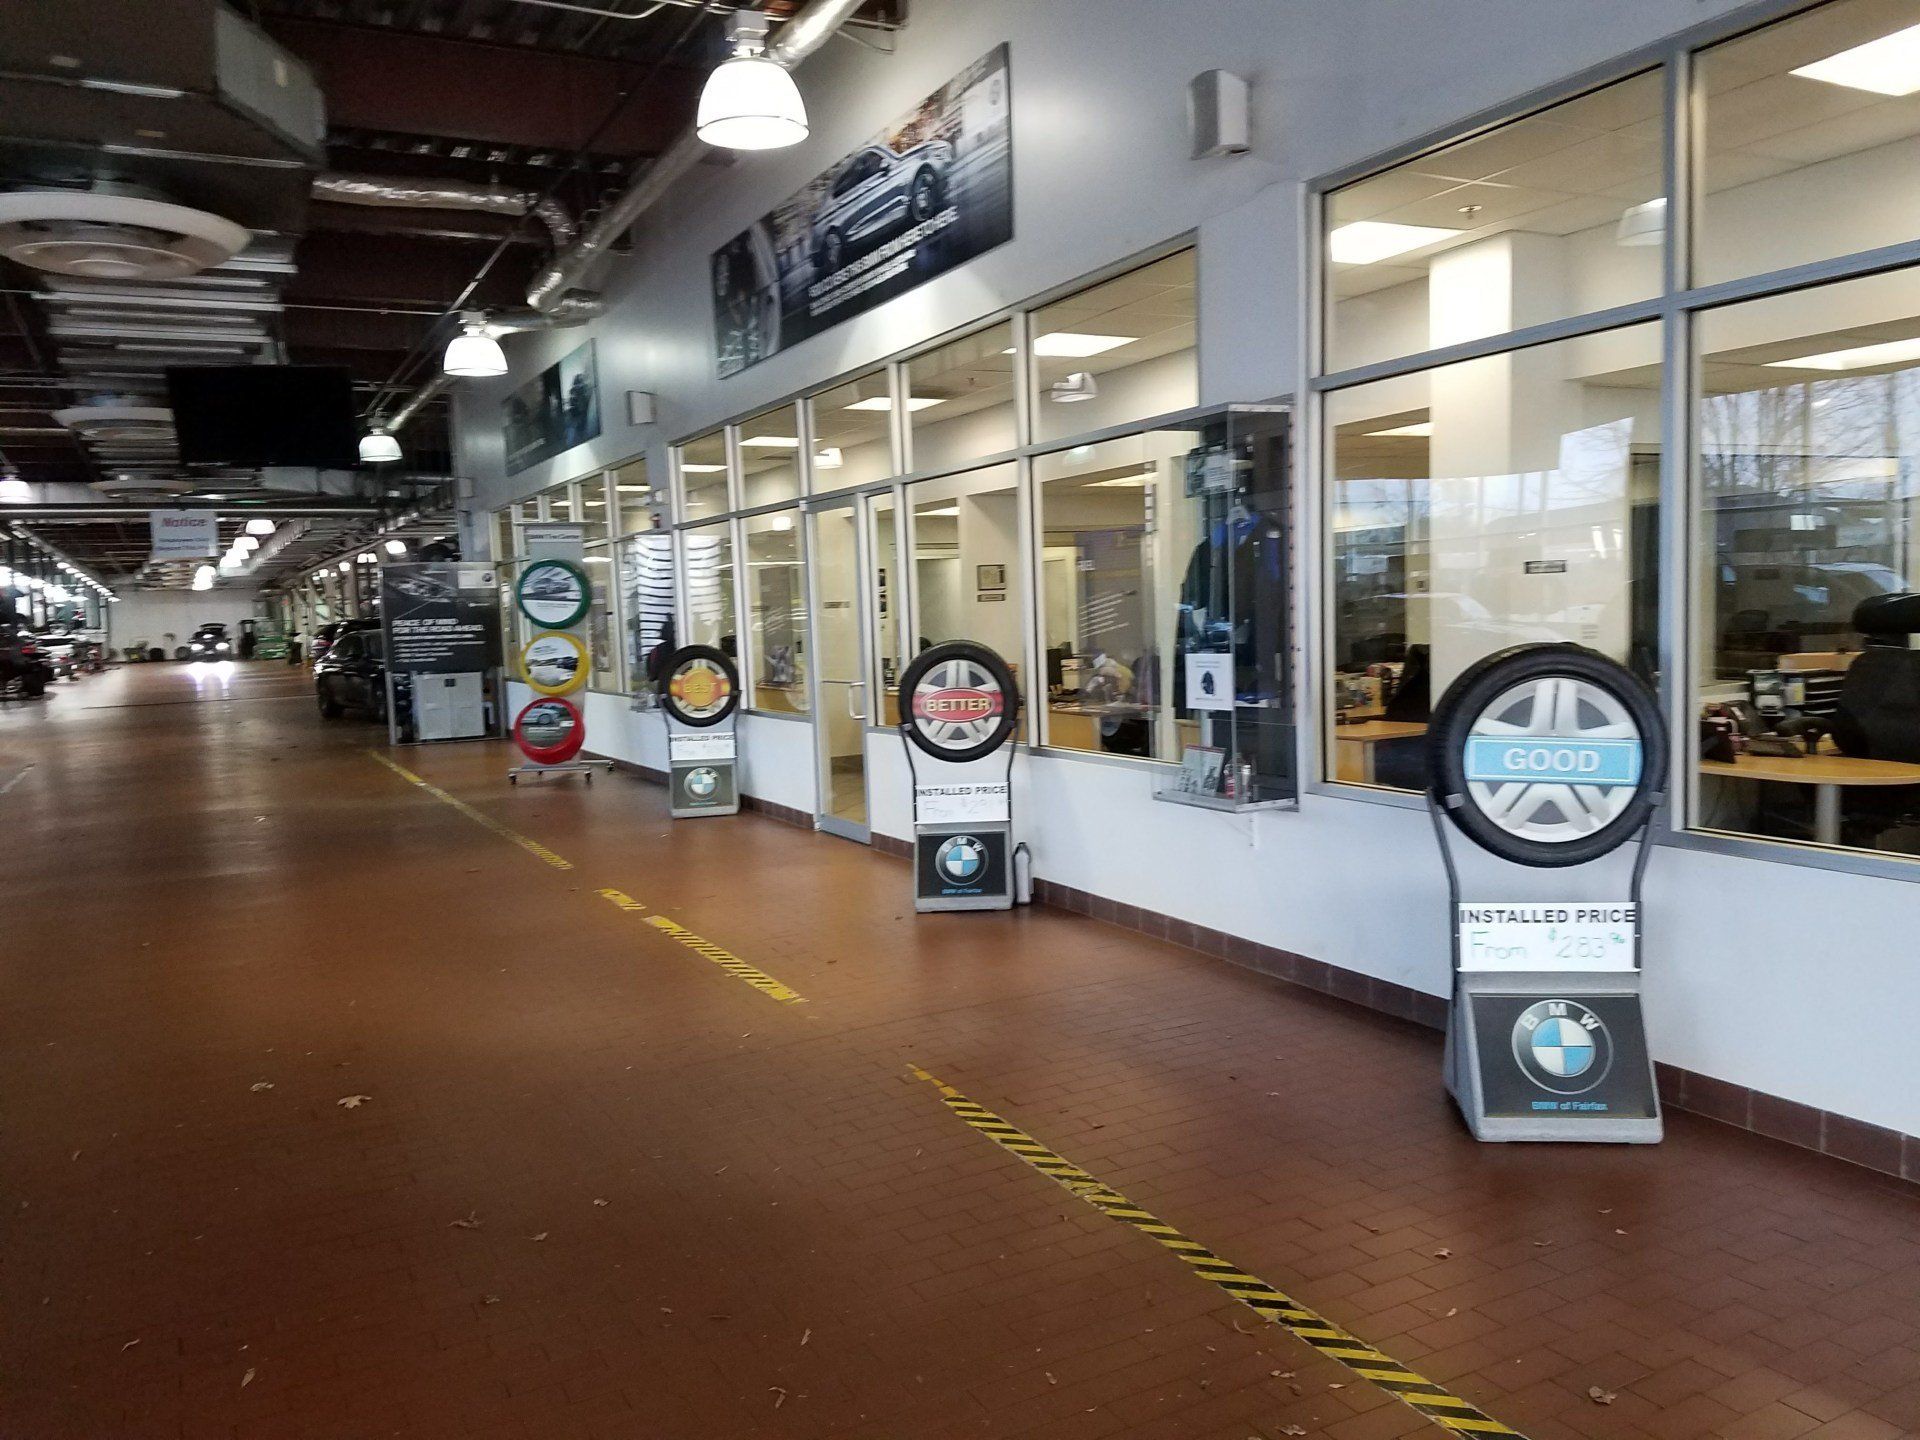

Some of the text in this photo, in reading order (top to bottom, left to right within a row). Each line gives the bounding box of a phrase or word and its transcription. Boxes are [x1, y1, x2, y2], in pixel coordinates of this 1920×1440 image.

[391, 619, 421, 627] PEACE
[422, 618, 435, 626] OF
[392, 626, 410, 634] FOR
[429, 625, 453, 633] ROAD
[684, 681, 717, 693] BEST
[926, 697, 991, 712] BETTER
[1503, 747, 1600, 773] GOOD
[917, 785, 1008, 797] INSTALLED PRICE
[1460, 909, 1636, 924] INSTALLED PRICE
[1471, 930, 1527, 960] From
[1519, 1002, 1601, 1031] BMW
[1559, 1101, 1571, 1110] of
[1572, 1101, 1608, 1111] Fairfax
